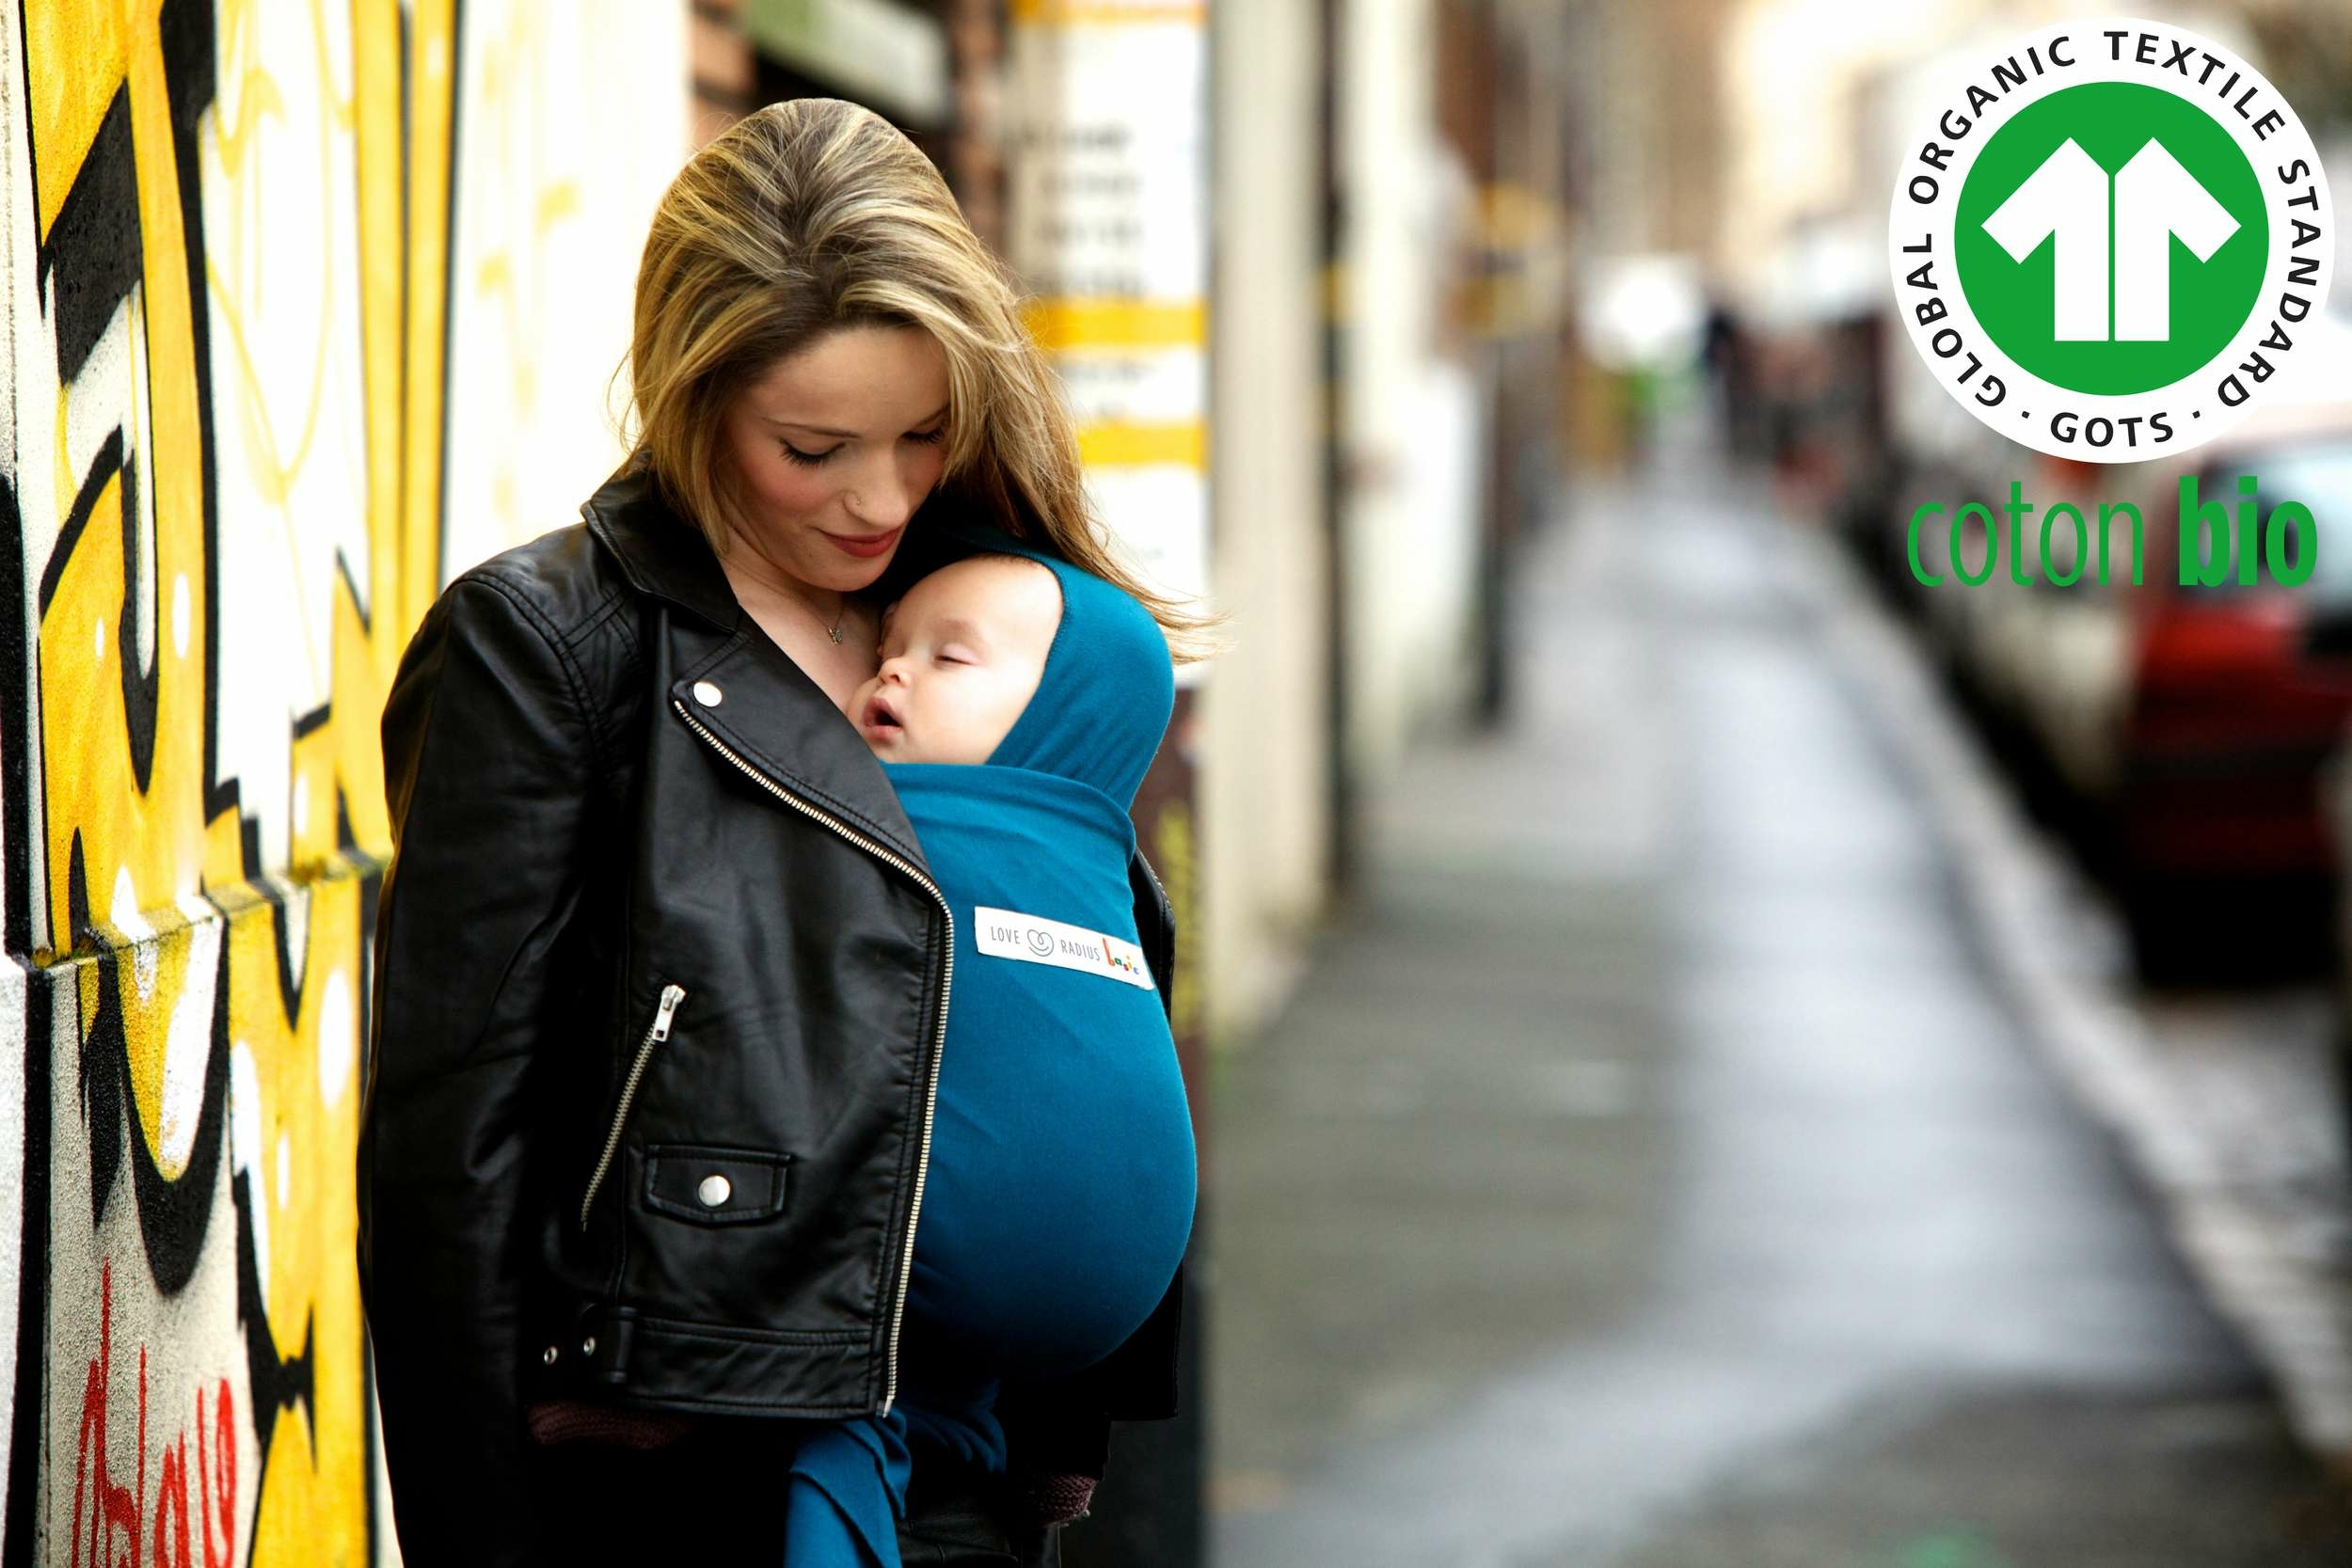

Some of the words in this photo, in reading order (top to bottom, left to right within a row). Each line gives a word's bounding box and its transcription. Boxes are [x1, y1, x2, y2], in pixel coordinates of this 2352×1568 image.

[991, 926, 1020, 944] LOVE
[1060, 940, 1101, 961] RADIUS
[1102, 937, 1139, 975] basic
